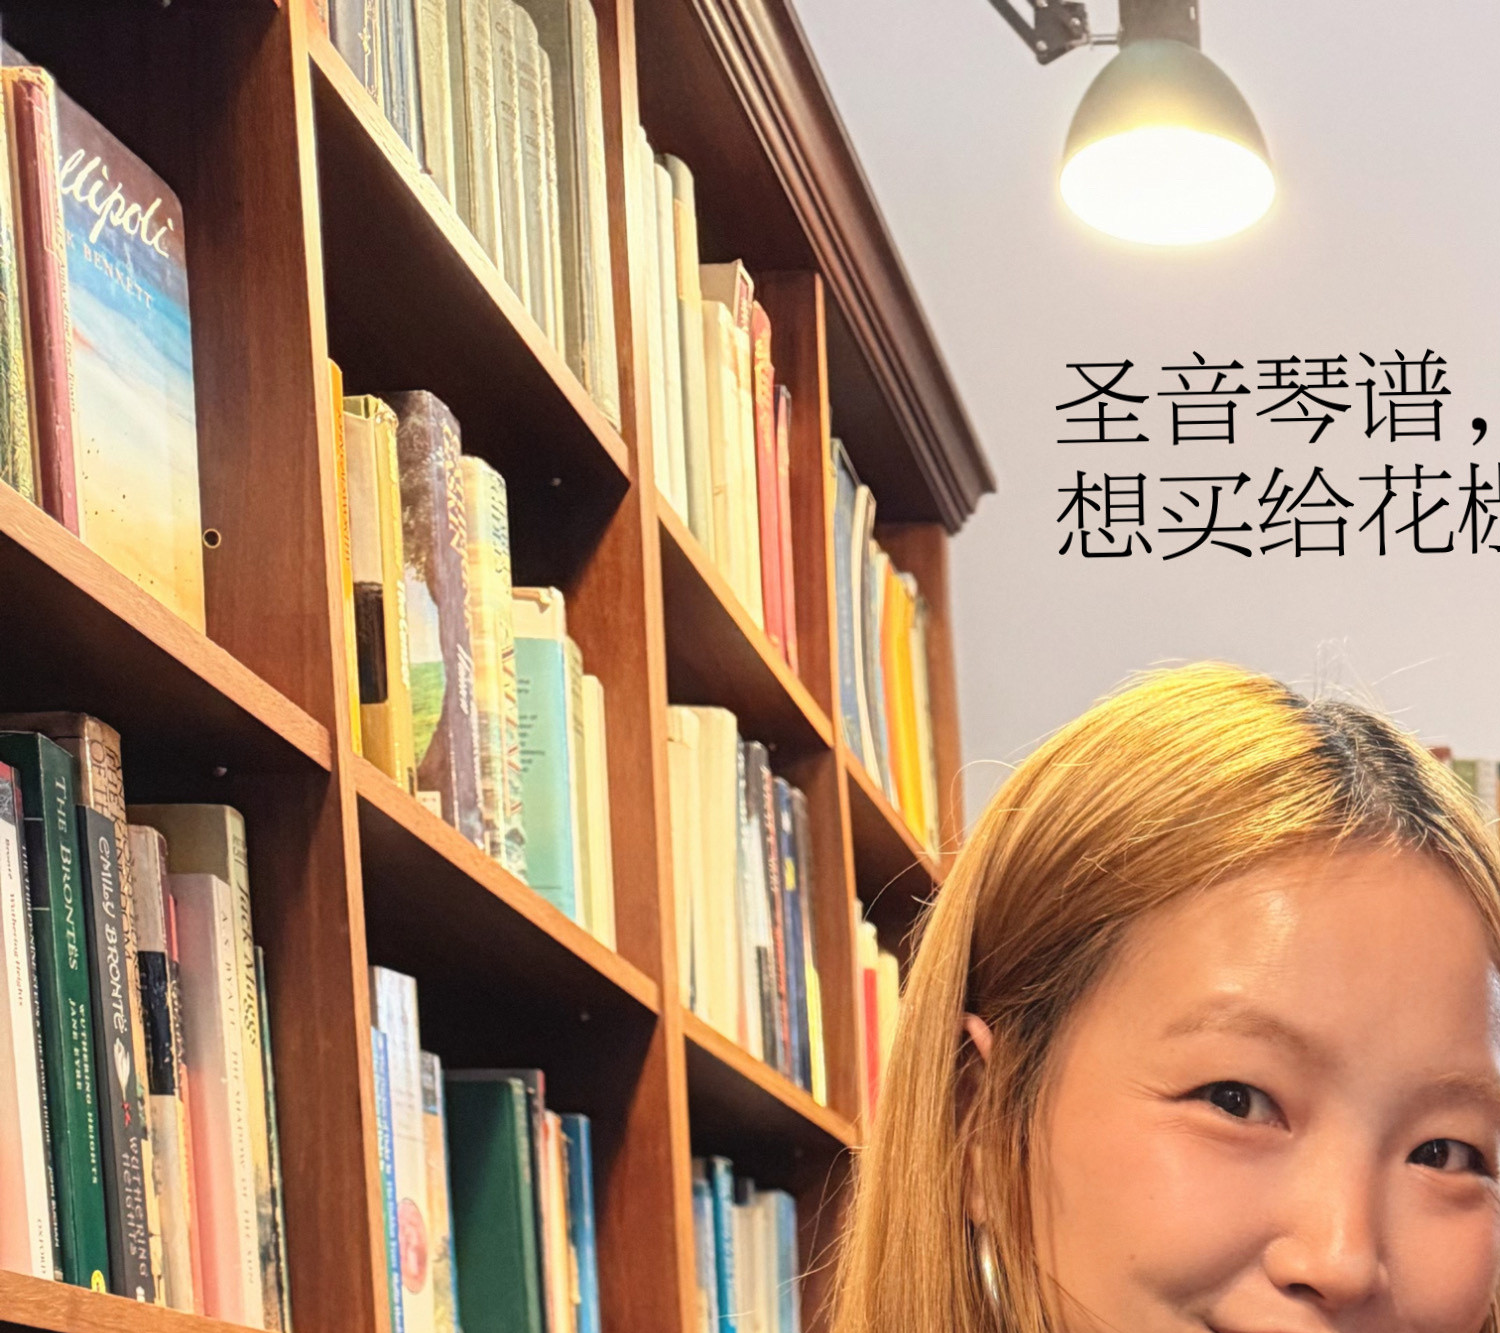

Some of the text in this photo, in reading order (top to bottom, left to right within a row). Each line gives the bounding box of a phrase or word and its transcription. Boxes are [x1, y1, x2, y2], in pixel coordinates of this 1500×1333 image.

[58, 149, 174, 258] llipoli
[83, 242, 153, 309] BENNETT
[54, 776, 69, 834] THE
[68, 997, 82, 1091] JANE EYRE
[239, 946, 261, 1053] Maggs
